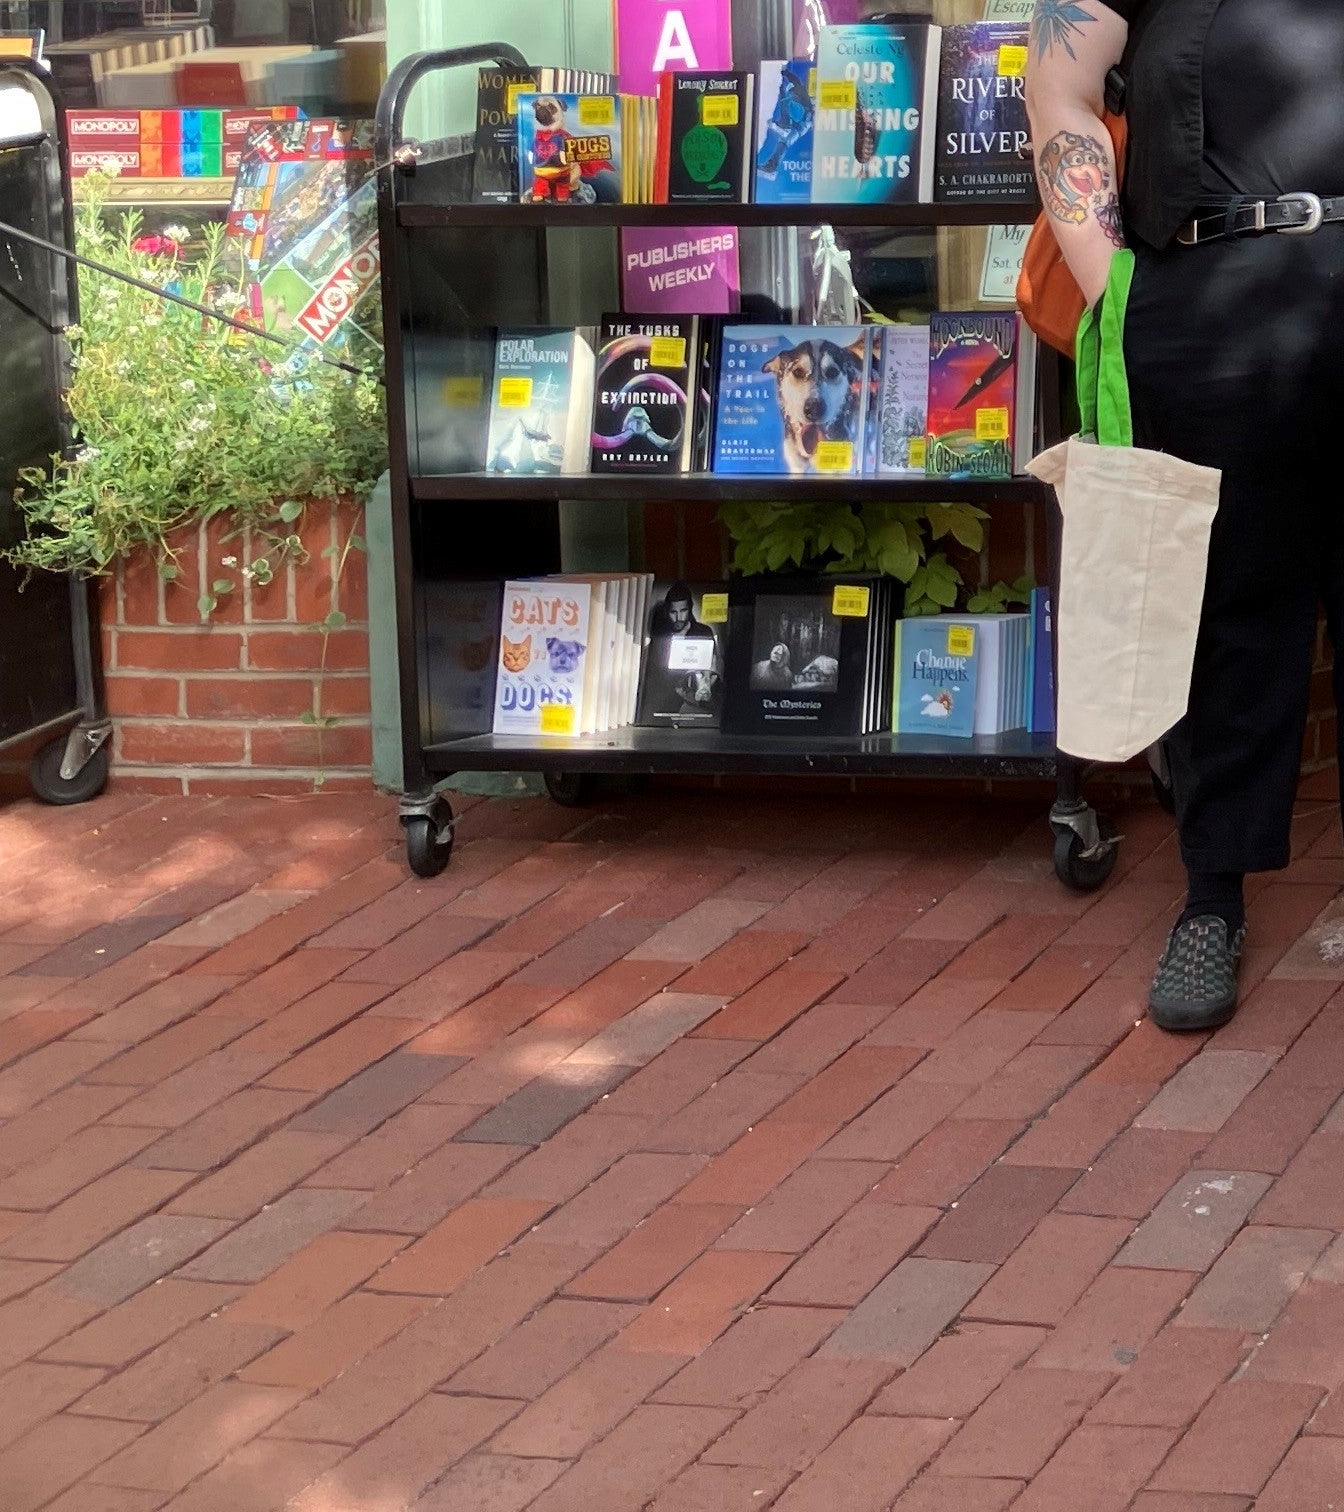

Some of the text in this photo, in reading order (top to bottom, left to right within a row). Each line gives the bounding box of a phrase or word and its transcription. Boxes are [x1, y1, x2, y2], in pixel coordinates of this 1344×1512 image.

[837, 42, 883, 56] Celeste
[845, 61, 896, 84] OUR
[951, 76, 1027, 103] RIVER
[480, 108, 516, 126] POW
[816, 108, 921, 131] MIING
[979, 109, 996, 121] OF
[74, 120, 138, 134] MONOPOLY
[565, 136, 611, 157] PUGS
[946, 130, 1032, 160] SILVER
[74, 153, 138, 167] MONOPOLY
[782, 160, 812, 171] TOUC
[820, 154, 911, 180] HEARTS
[939, 176, 948, 187] S.
[962, 172, 1033, 186] CHAKRABORTY
[626, 233, 734, 271] PUBLISHERS
[648, 261, 716, 292] WEEKLY
[303, 236, 379, 336] MONOP
[608, 324, 680, 337] THE TUSKS
[500, 339, 535, 352] POLAR
[727, 343, 769, 354] DOGS
[498, 349, 569, 364] EXPLORATION
[727, 359, 747, 369] ON
[633, 358, 650, 371] OF
[726, 374, 754, 385] THE
[600, 391, 678, 405] EXTINCTION
[725, 389, 771, 400] TRAIL
[509, 596, 580, 627] CATS
[915, 648, 968, 670] Change
[500, 683, 573, 711] DOGS
